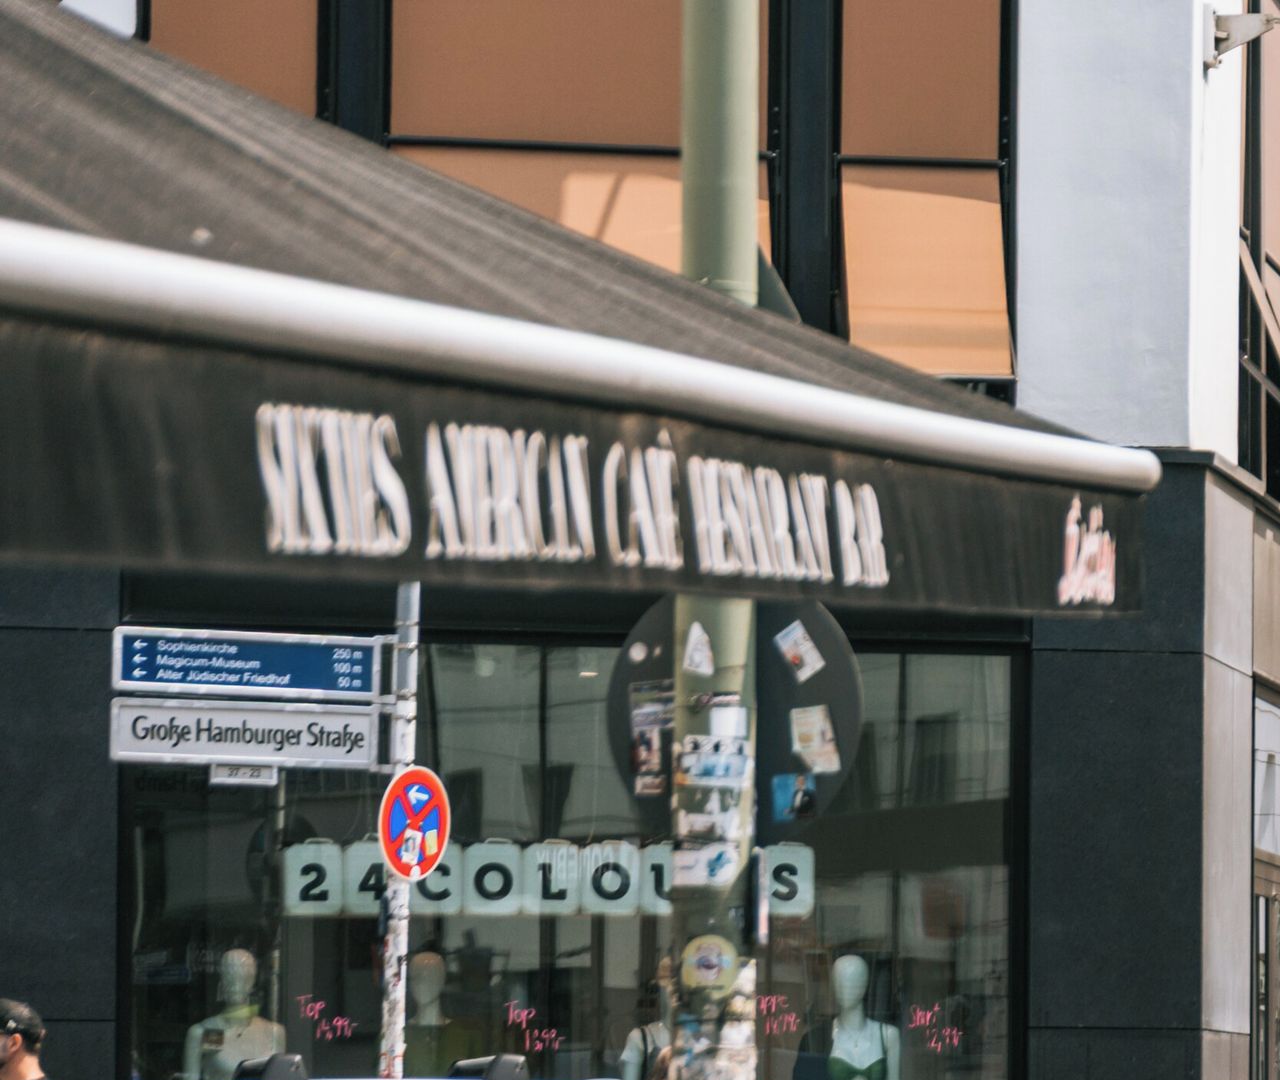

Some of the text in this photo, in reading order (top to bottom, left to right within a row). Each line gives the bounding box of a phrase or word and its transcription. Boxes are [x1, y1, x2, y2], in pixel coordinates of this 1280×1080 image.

[157, 639, 363, 660] Sophienkirche 250 m
[156, 654, 362, 674] Magicum-Museum 100 m
[156, 668, 362, 688] Alter Jüdischer Friedhof 50 m
[131, 715, 365, 754] Große Hamburger Straße
[227, 766, 240, 778] 37
[249, 767, 262, 779] 23
